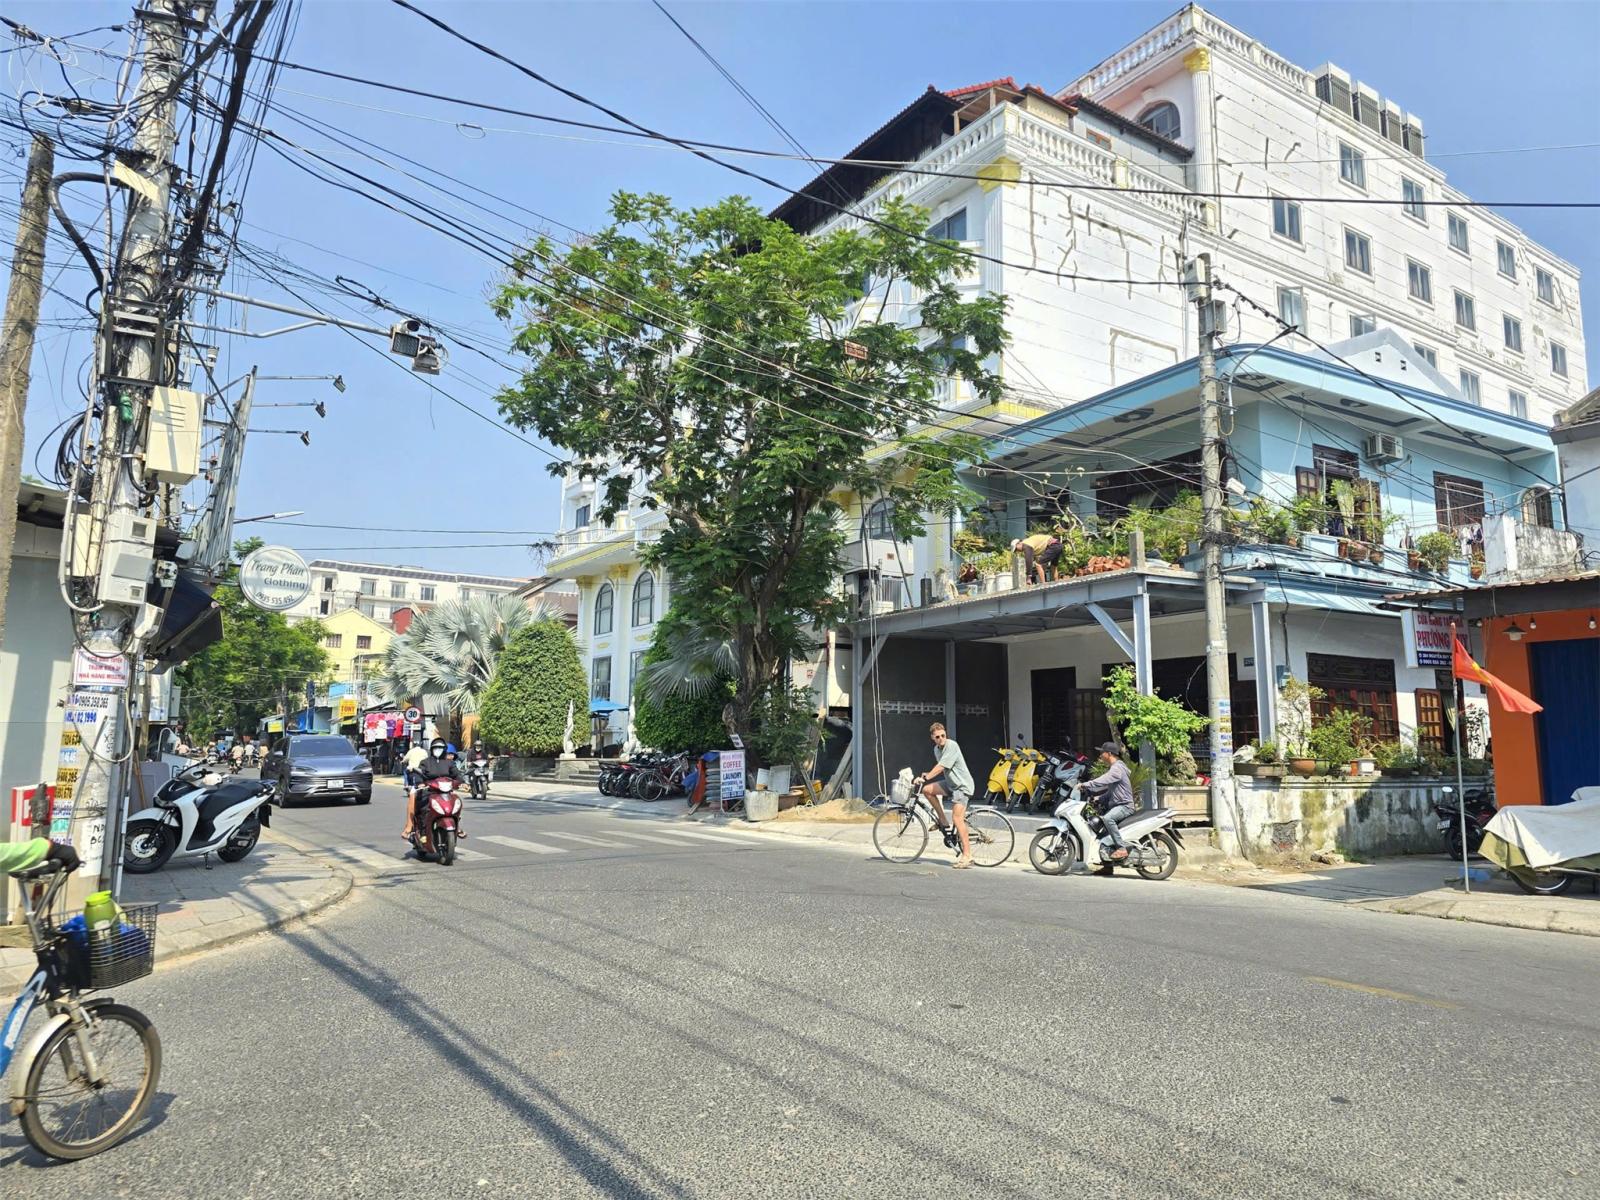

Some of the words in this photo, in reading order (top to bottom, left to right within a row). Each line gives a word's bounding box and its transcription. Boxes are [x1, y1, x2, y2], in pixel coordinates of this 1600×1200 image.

[251, 560, 279, 577] Trang
[280, 562, 304, 577] Phan
[264, 577, 306, 590] Clothing
[408, 710, 417, 718] 30
